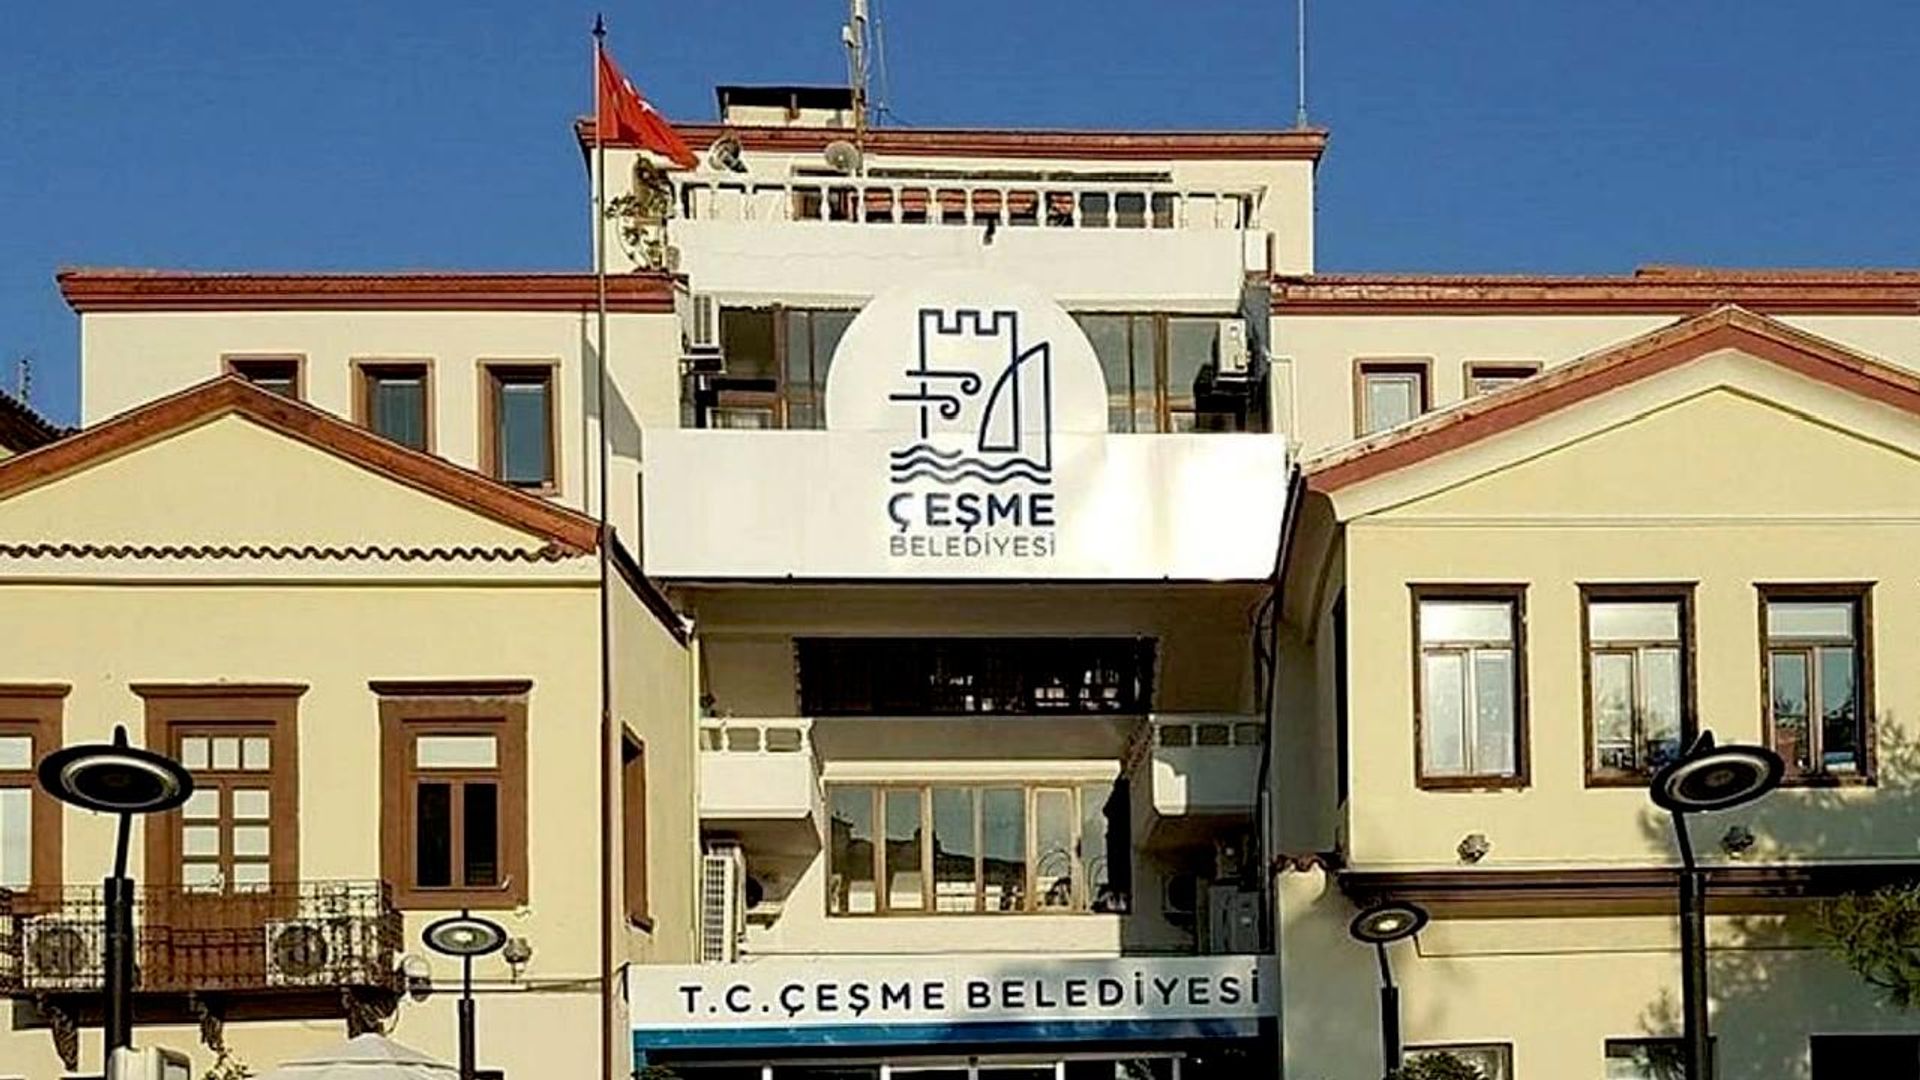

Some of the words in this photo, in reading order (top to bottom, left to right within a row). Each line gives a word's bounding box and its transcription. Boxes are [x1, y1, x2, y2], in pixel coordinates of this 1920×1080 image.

[888, 492, 1055, 533] ÇEŞME
[889, 532, 1055, 557] BELEDİYESİ
[967, 969, 1259, 1009] BELEDİYESİ
